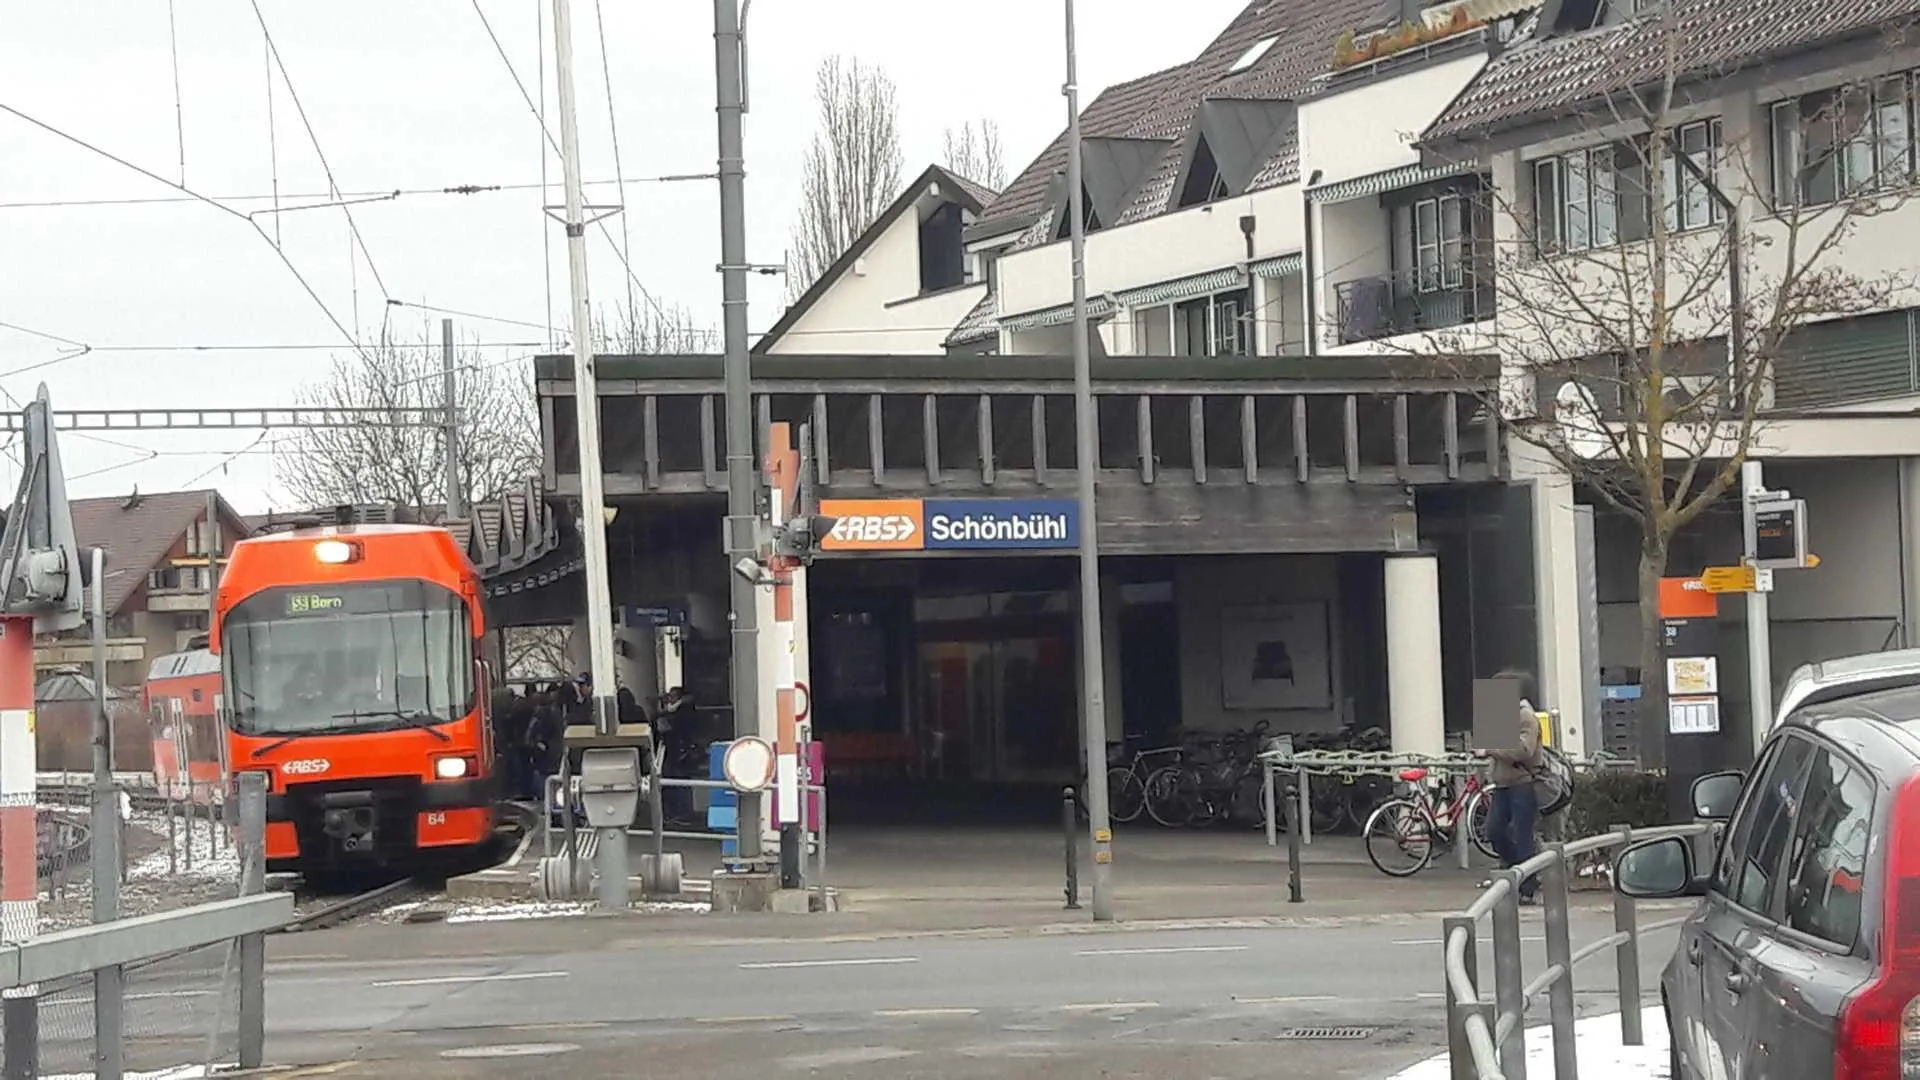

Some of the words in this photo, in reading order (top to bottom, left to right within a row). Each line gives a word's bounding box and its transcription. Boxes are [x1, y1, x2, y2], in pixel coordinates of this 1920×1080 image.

[844, 516, 905, 540] RBS
[930, 514, 1067, 540] Schönbühl
[291, 760, 323, 774] RBS
[427, 812, 446, 826] 64
